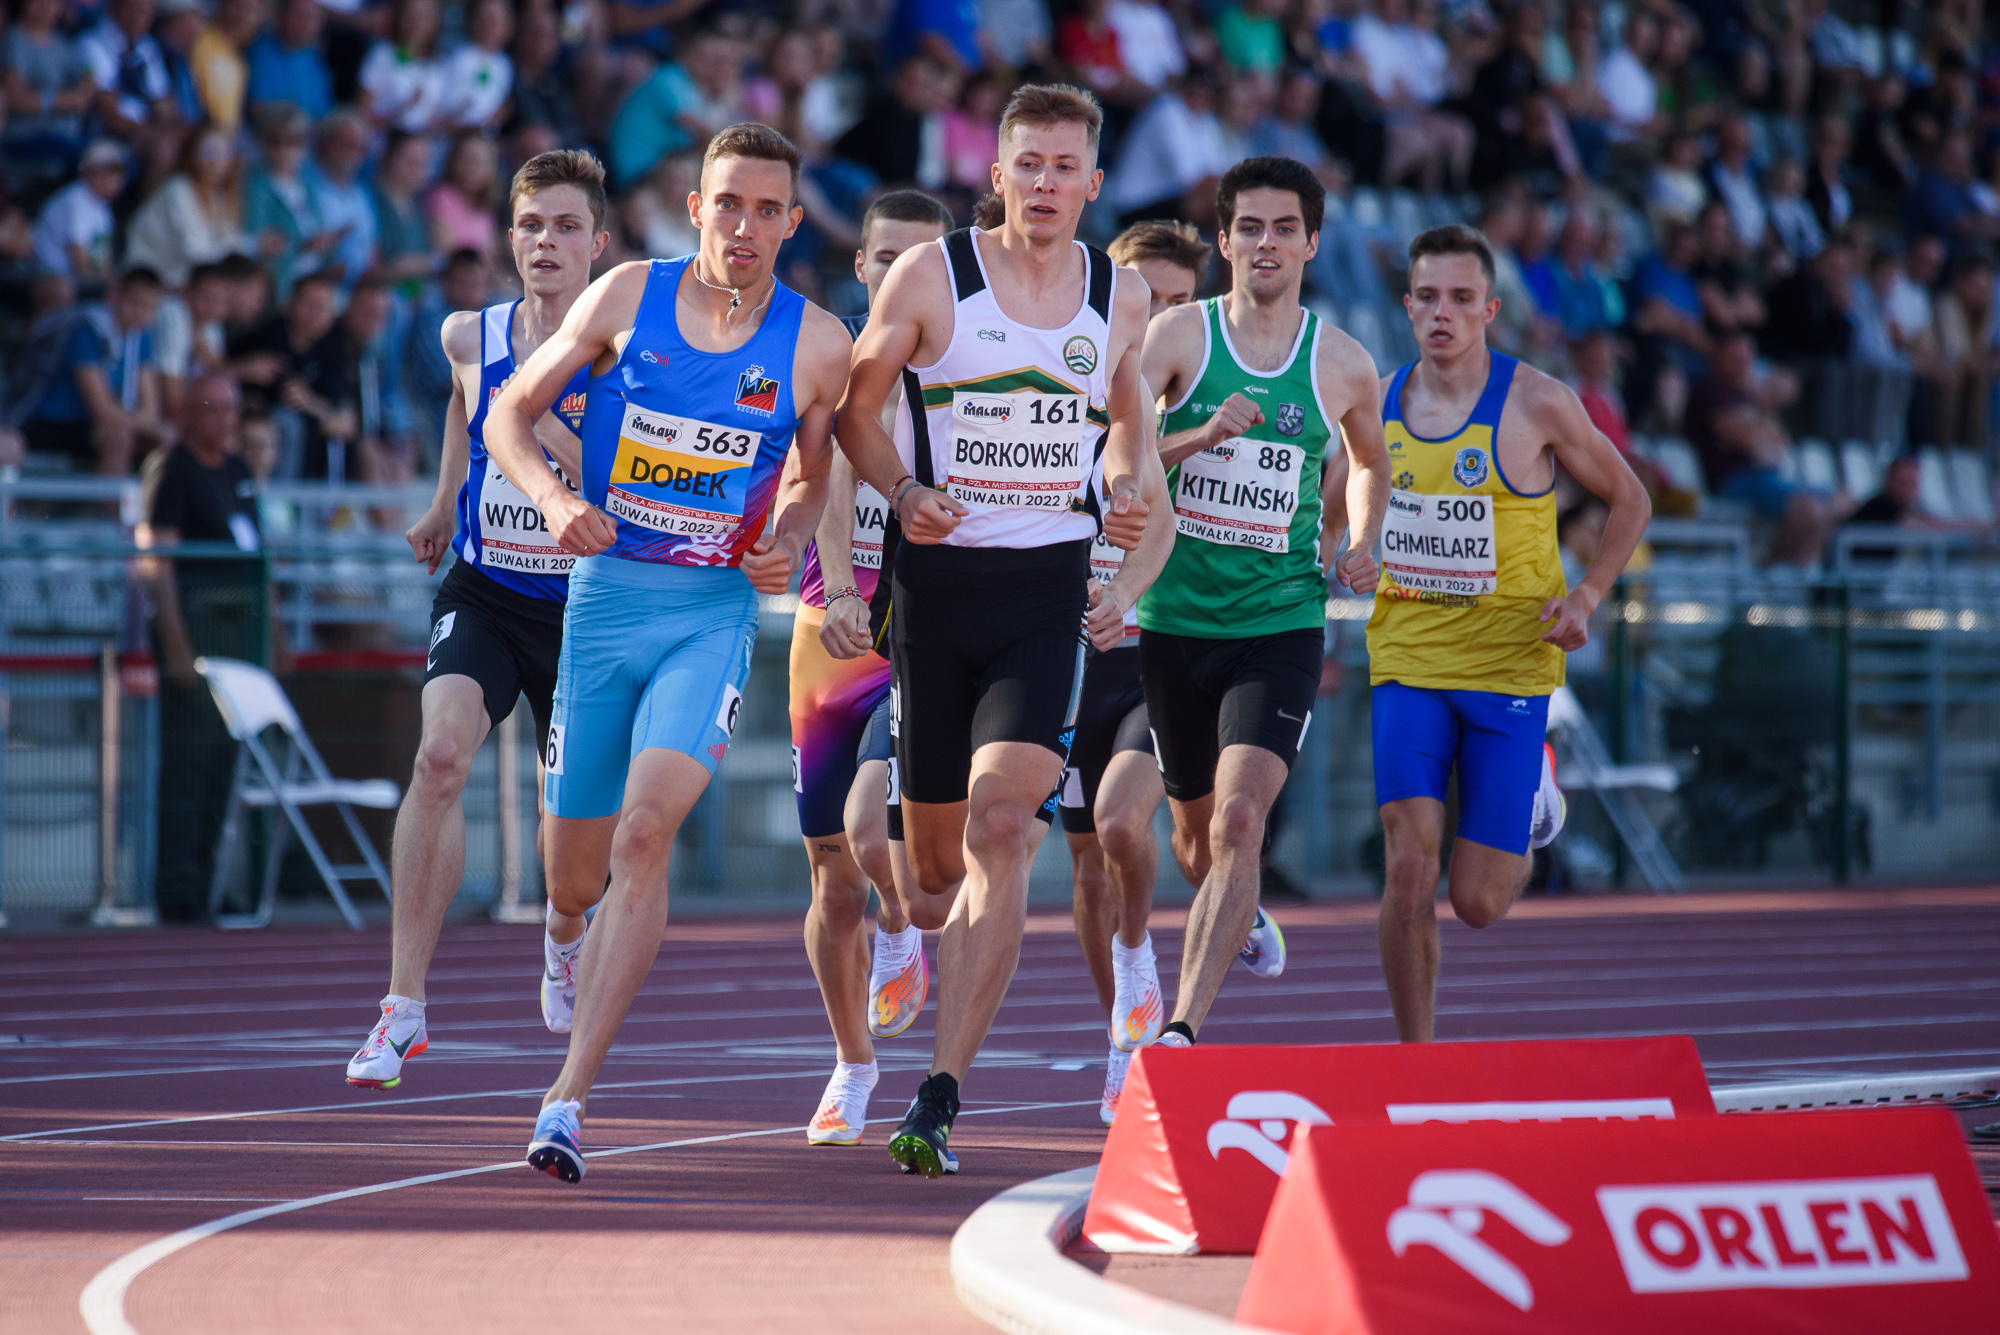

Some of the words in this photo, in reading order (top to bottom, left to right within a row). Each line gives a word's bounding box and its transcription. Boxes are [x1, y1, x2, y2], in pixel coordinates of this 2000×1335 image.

[977, 329, 1006, 343] esa
[640, 350, 669, 366] esa
[1069, 342, 1094, 359] RKS
[736, 406, 771, 419] SZCZECIN
[1030, 399, 1079, 424] 161
[693, 427, 751, 457] 563
[955, 437, 1079, 468] BORKOWSKI
[1258, 447, 1292, 472] 88
[630, 456, 730, 499] DOBEK
[953, 477, 966, 485] 98.
[968, 480, 990, 488] PZLA
[992, 482, 1051, 491] MISTRZOSTWA
[954, 488, 1020, 505] SUWAŁKI
[1025, 495, 1060, 507] 2022
[1181, 473, 1294, 513] KITLIŃSKI
[612, 500, 675, 530] SUWAŁKI
[678, 520, 715, 534] 2022
[625, 494, 646, 507] PZLA
[646, 501, 707, 520] MISTRZOSTWA
[708, 513, 738, 523] POLSKI
[1437, 500, 1486, 522] 500
[1178, 519, 1236, 542] SUWAŁKI
[1240, 533, 1273, 548] 2022
[1191, 512, 1210, 522] PZLA
[1210, 517, 1265, 532] MISTRZOSTWA
[500, 542, 517, 551] PZLA
[854, 541, 883, 551] MISTRZ
[1385, 530, 1489, 559] CHMIELARZ
[489, 551, 545, 569] SUWAŁKI
[1389, 573, 1442, 589] SUWAŁKI
[1445, 580, 1476, 593] 2022
[726, 697, 741, 736] 6
[547, 727, 558, 769] 6
[818, 844, 841, 853] run
[1634, 1197, 1937, 1273] ORLEN
